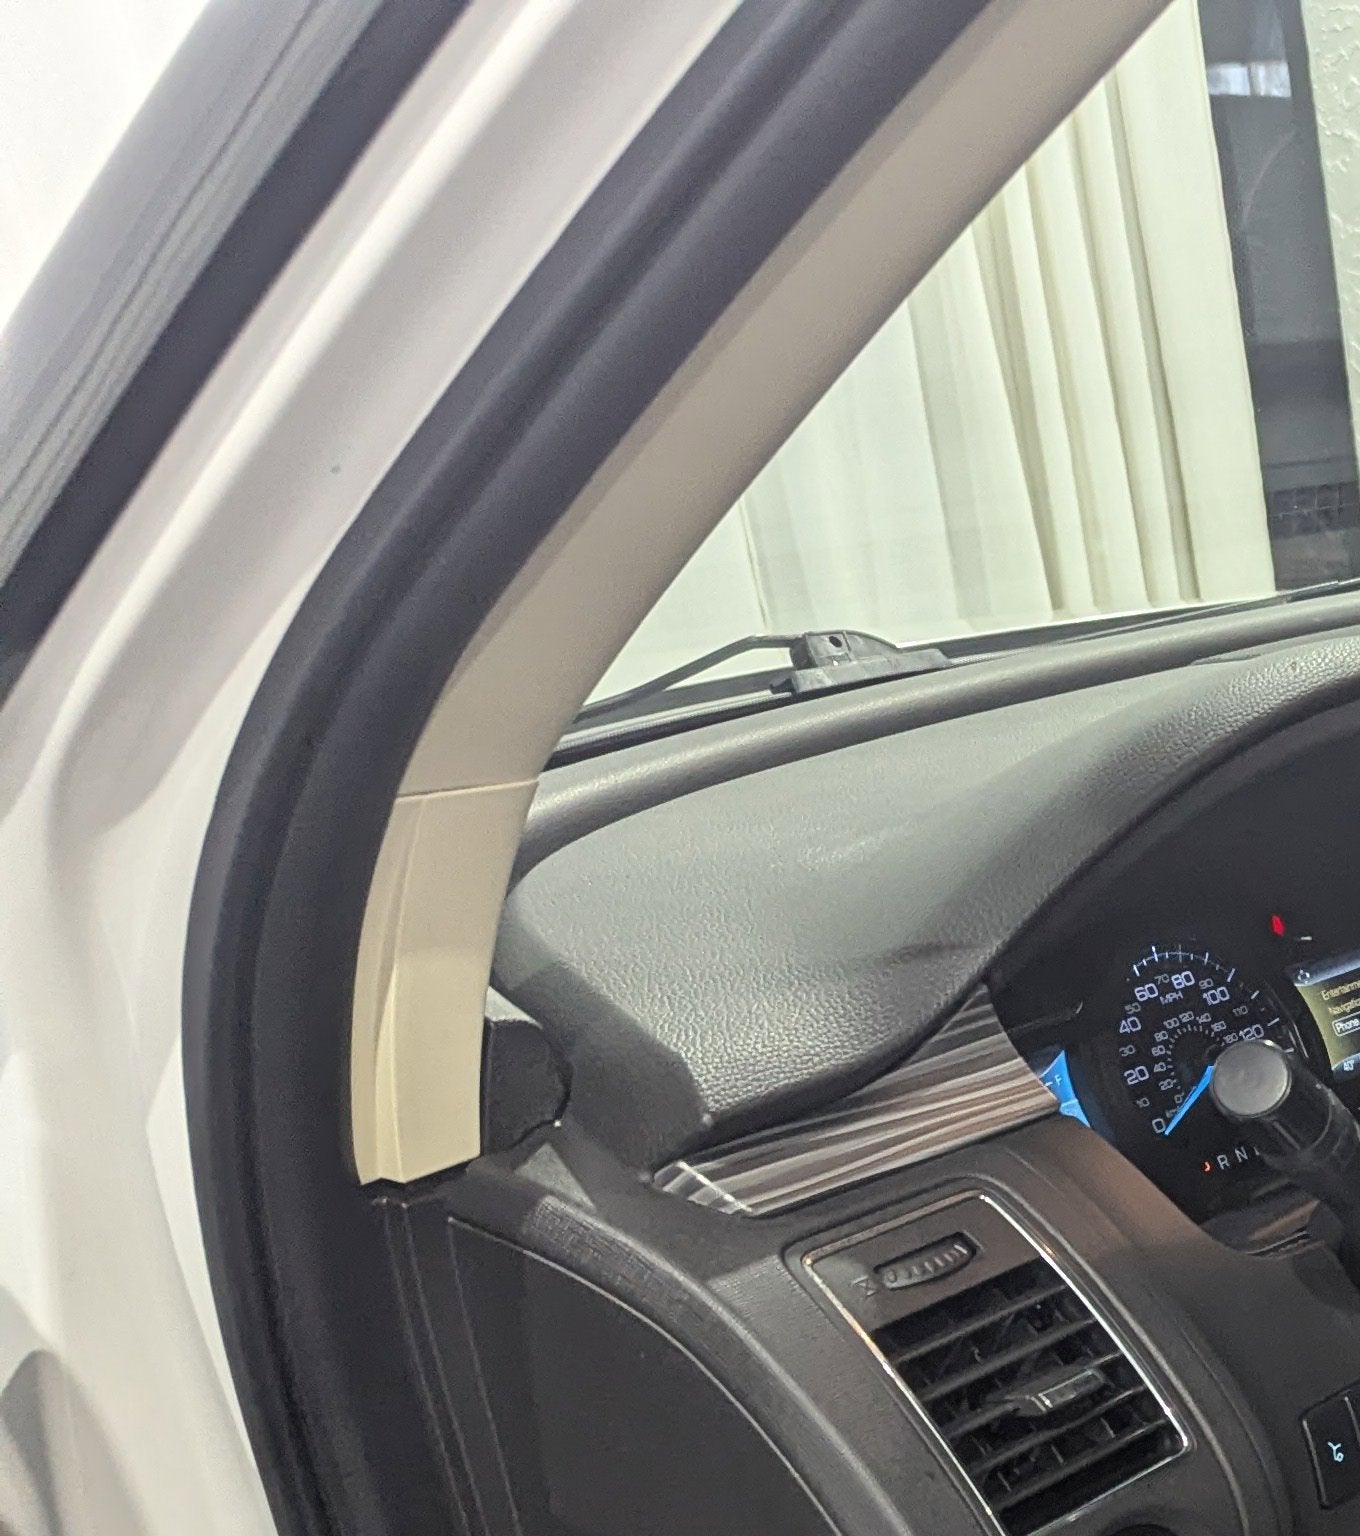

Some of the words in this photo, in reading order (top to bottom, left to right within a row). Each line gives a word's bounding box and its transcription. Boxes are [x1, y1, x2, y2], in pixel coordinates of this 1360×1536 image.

[1154, 973, 1169, 985] 70
[1171, 971, 1195, 990] 80
[1199, 978, 1214, 990] 90
[1134, 983, 1159, 1002] 60
[1160, 990, 1184, 1005] MPH
[1202, 986, 1230, 1006] 100
[1124, 1002, 1141, 1014] 50
[1232, 1005, 1249, 1017] 110
[1163, 1017, 1180, 1029] 100
[1179, 1011, 1195, 1023] 120
[1119, 1016, 1142, 1034] 40
[1335, 1018, 1360, 1033] Phone
[1154, 1030, 1169, 1042] 80
[1239, 1023, 1265, 1041] 120
[1119, 1044, 1136, 1057] 30
[1153, 1061, 1167, 1073] 40
[1054, 1074, 1062, 1086] F
[1123, 1065, 1150, 1086] 20
[1159, 1079, 1174, 1091] 20
[1136, 1096, 1151, 1108] 10
[1151, 1118, 1166, 1134] 0
[1217, 1154, 1230, 1170] R
[1234, 1146, 1249, 1163] N
